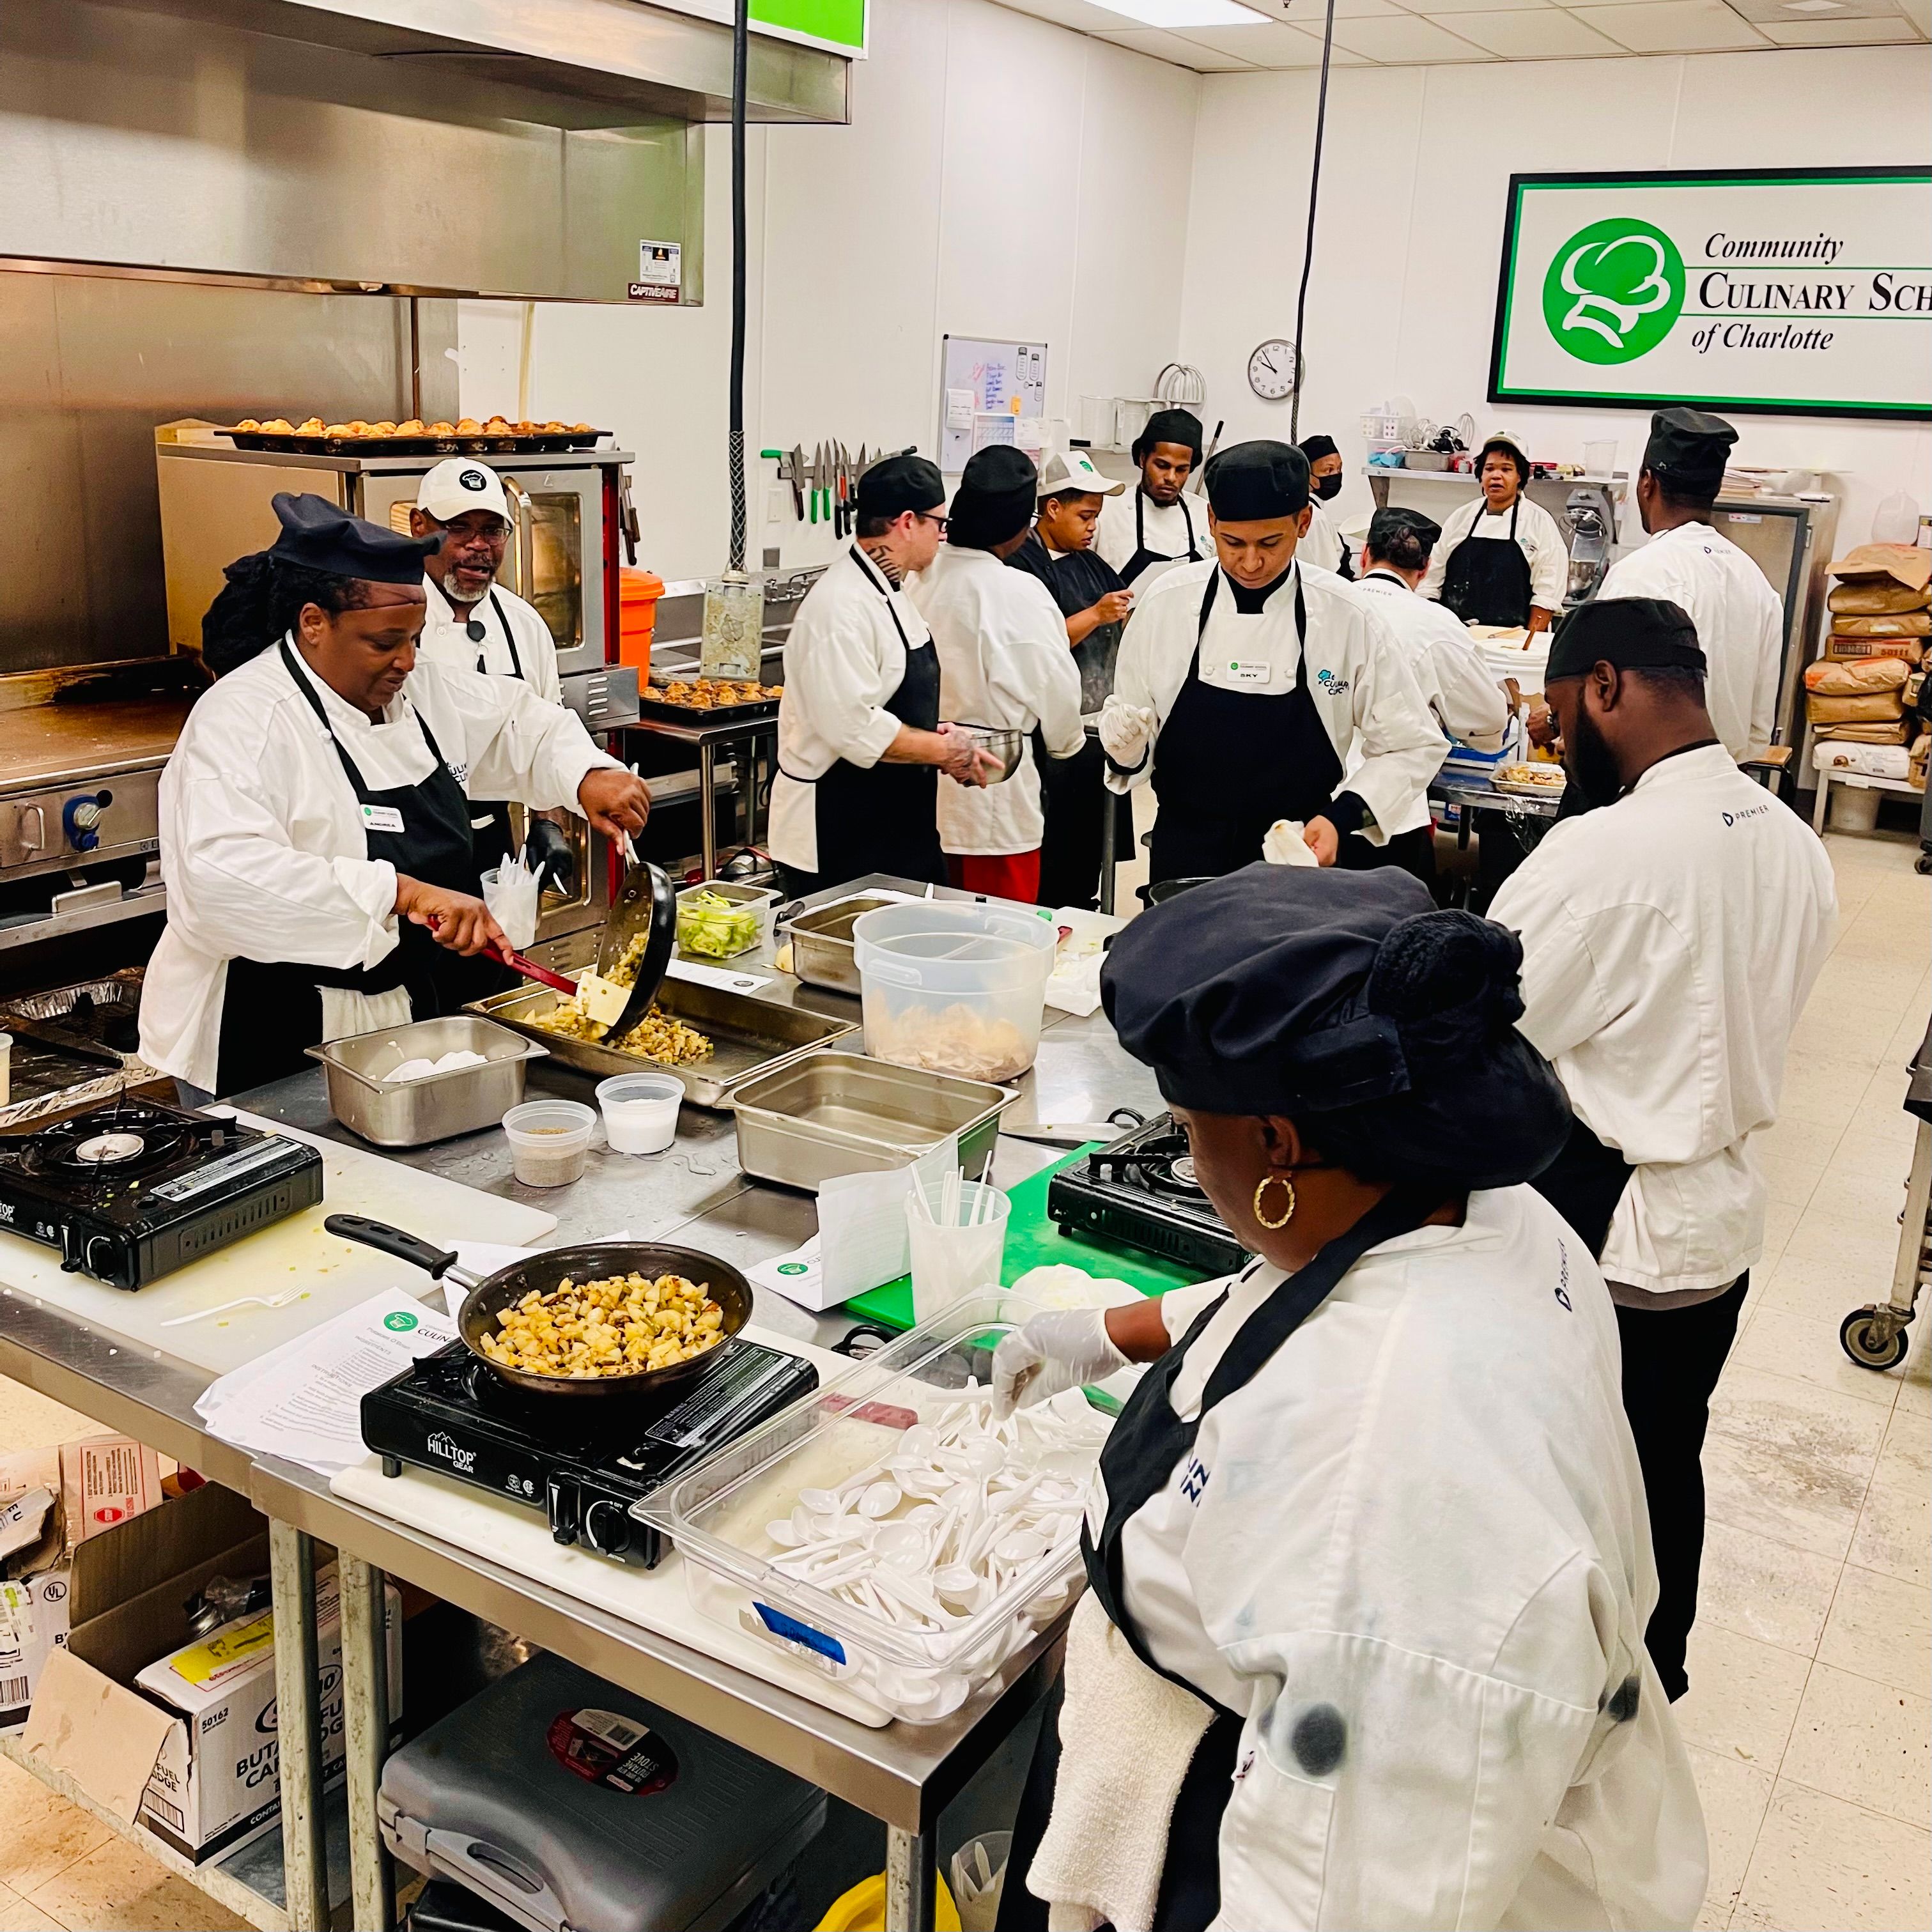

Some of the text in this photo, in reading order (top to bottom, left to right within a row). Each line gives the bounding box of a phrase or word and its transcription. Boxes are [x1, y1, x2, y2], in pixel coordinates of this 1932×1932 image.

[1704, 232, 1844, 265] Community
[1699, 272, 1855, 309] CULINARY
[1691, 322, 1834, 354] of Charlotte
[1735, 804, 1770, 821] PREMIER
[427, 1438, 474, 1465] HILLTOP
[452, 1460, 474, 1474] GEAR
[202, 1707, 229, 1730] 50162
[156, 1763, 180, 1784] FUEL
[630, 1752, 660, 1772] STOVE
